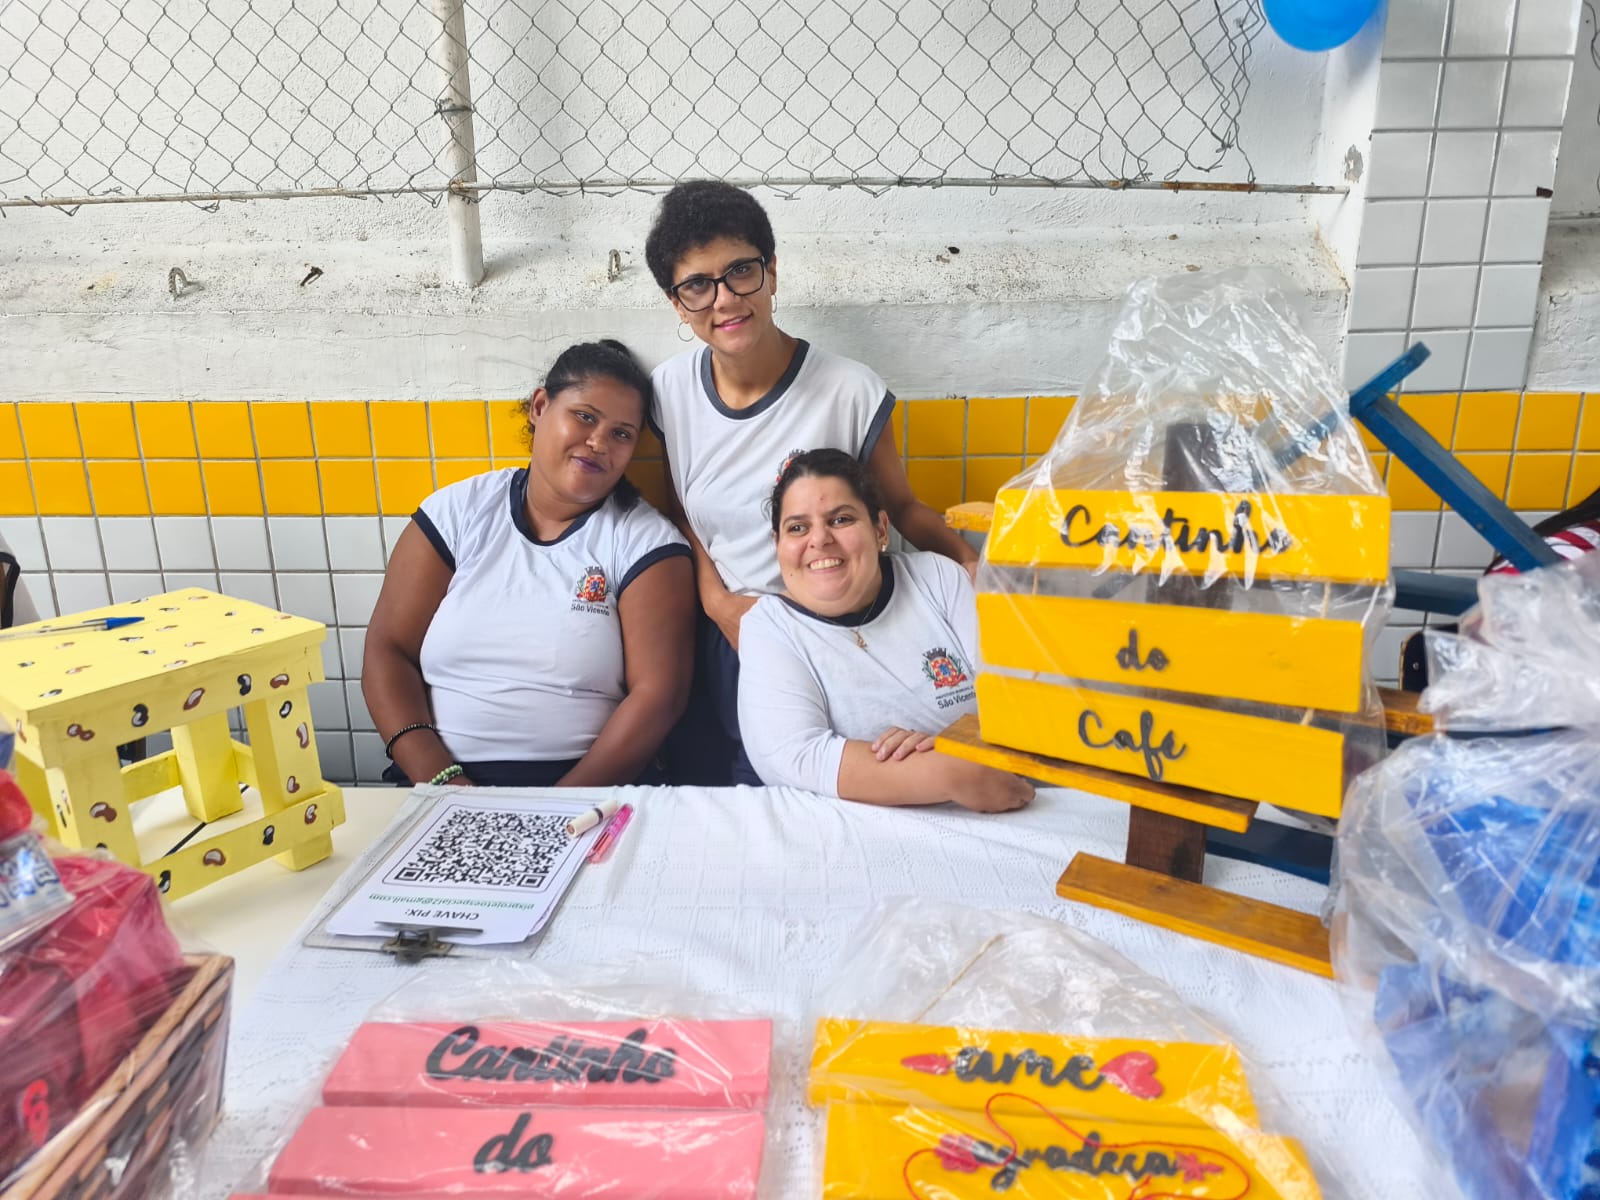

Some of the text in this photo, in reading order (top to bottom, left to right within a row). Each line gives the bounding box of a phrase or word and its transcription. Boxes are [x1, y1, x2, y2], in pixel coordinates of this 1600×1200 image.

[1060, 500, 1293, 554] Cantinho
[1115, 628, 1170, 672] do
[405, 909, 480, 921] CHAVE PIX:
[425, 1025, 676, 1084] Cantinho
[954, 1046, 1105, 1091] ame
[473, 1112, 554, 1174] do
